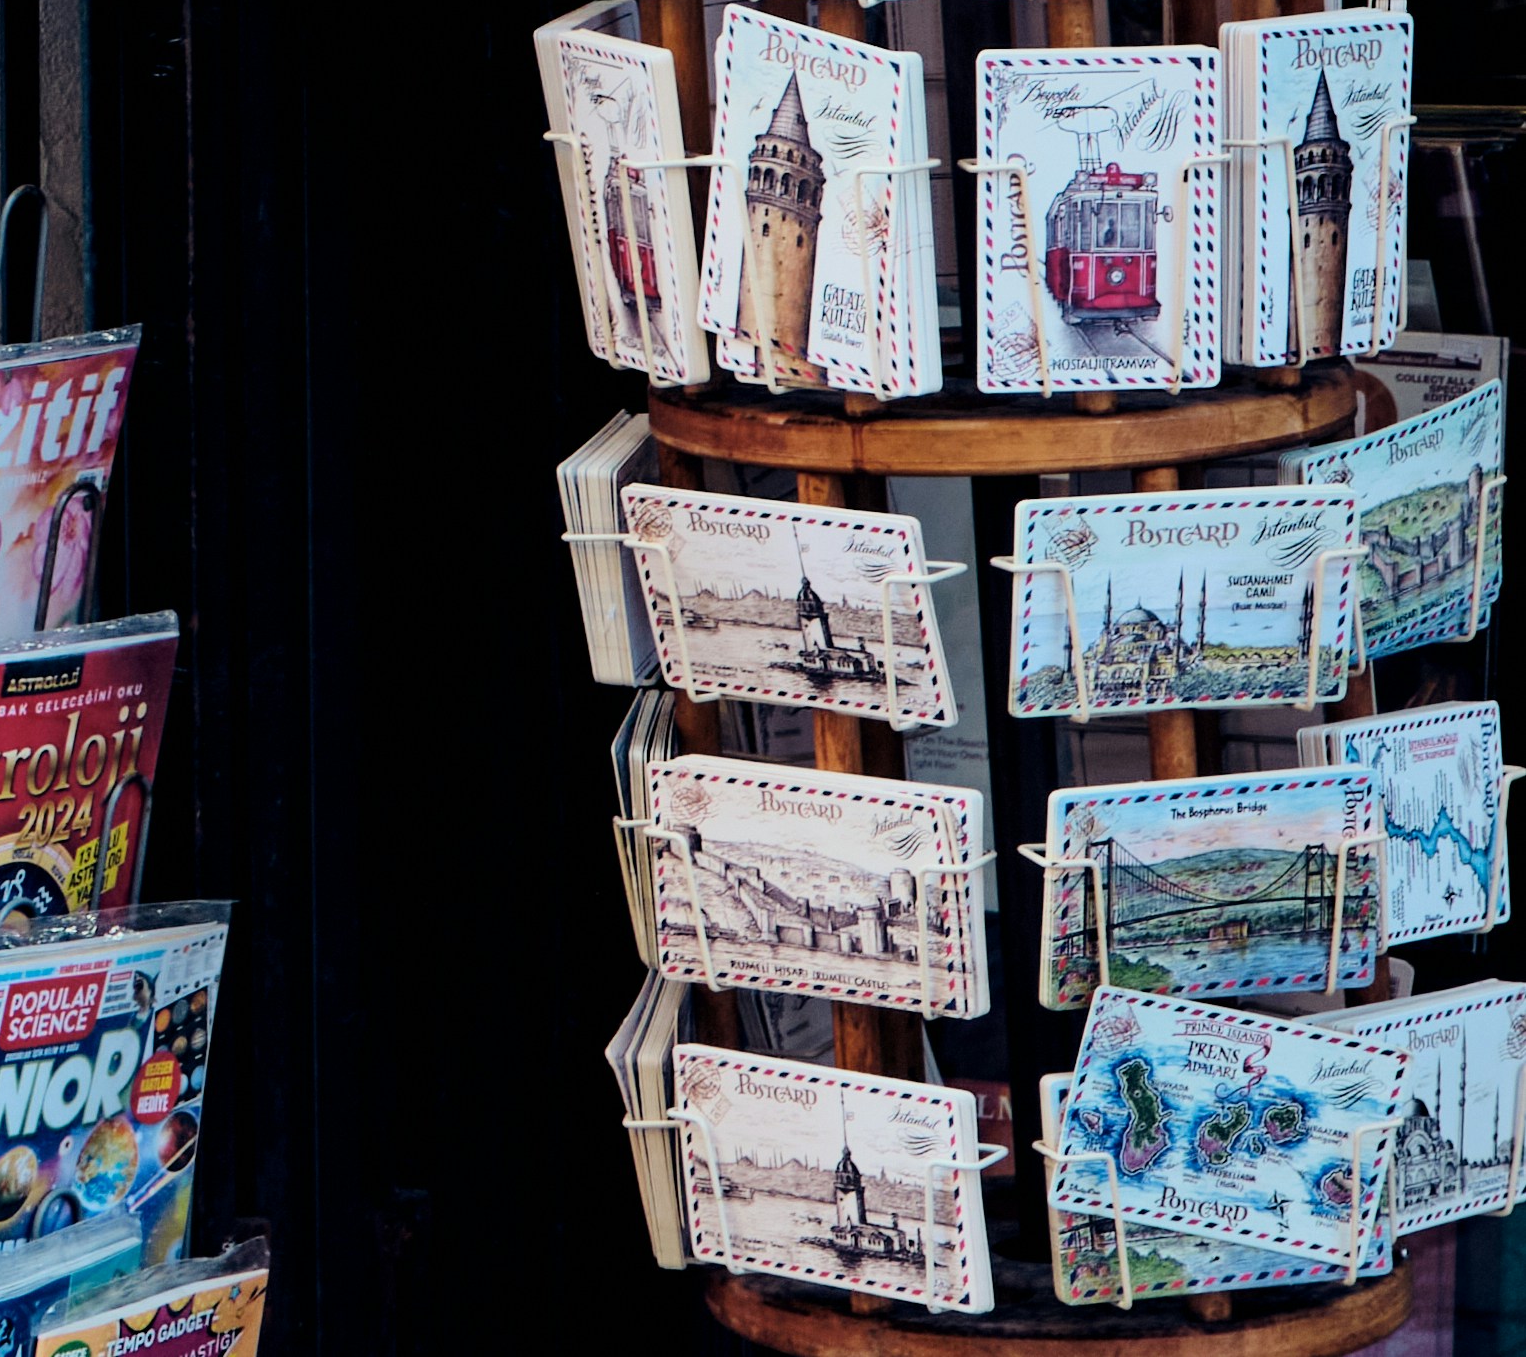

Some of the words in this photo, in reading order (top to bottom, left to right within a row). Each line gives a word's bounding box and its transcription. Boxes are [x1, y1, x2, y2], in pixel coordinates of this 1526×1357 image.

[812, 95, 878, 130] İstanbul
[1395, 372, 1445, 385] COLLECT
[1120, 519, 1240, 549] POSTCARD
[1250, 509, 1326, 546] İstanbul
[34, 685, 113, 715] GELECEĞİNİ
[116, 683, 143, 699] OKU
[14, 791, 95, 849] 2024
[1171, 805, 1185, 819] The
[8, 983, 100, 1018] POPULAR
[1187, 1039, 1241, 1064] PRENS
